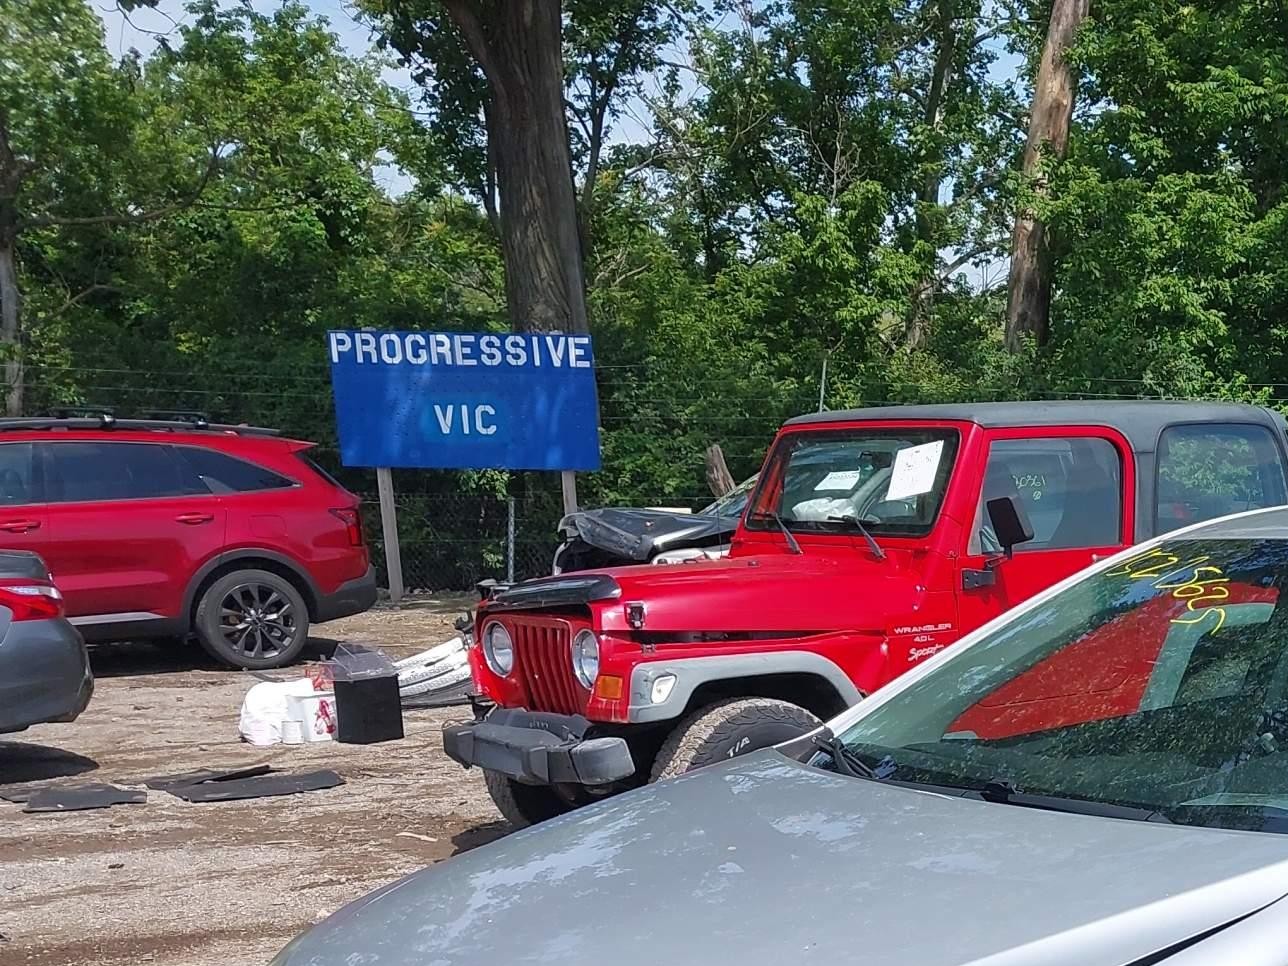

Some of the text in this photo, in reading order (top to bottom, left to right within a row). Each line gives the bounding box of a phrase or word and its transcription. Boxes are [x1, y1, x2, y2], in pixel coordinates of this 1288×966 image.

[329, 333, 590, 368] PROGRESSIVE
[433, 404, 497, 435] VIC
[893, 622, 952, 634] WRANGLER
[907, 643, 945, 662] Sport
[726, 736, 750, 758] T/A
